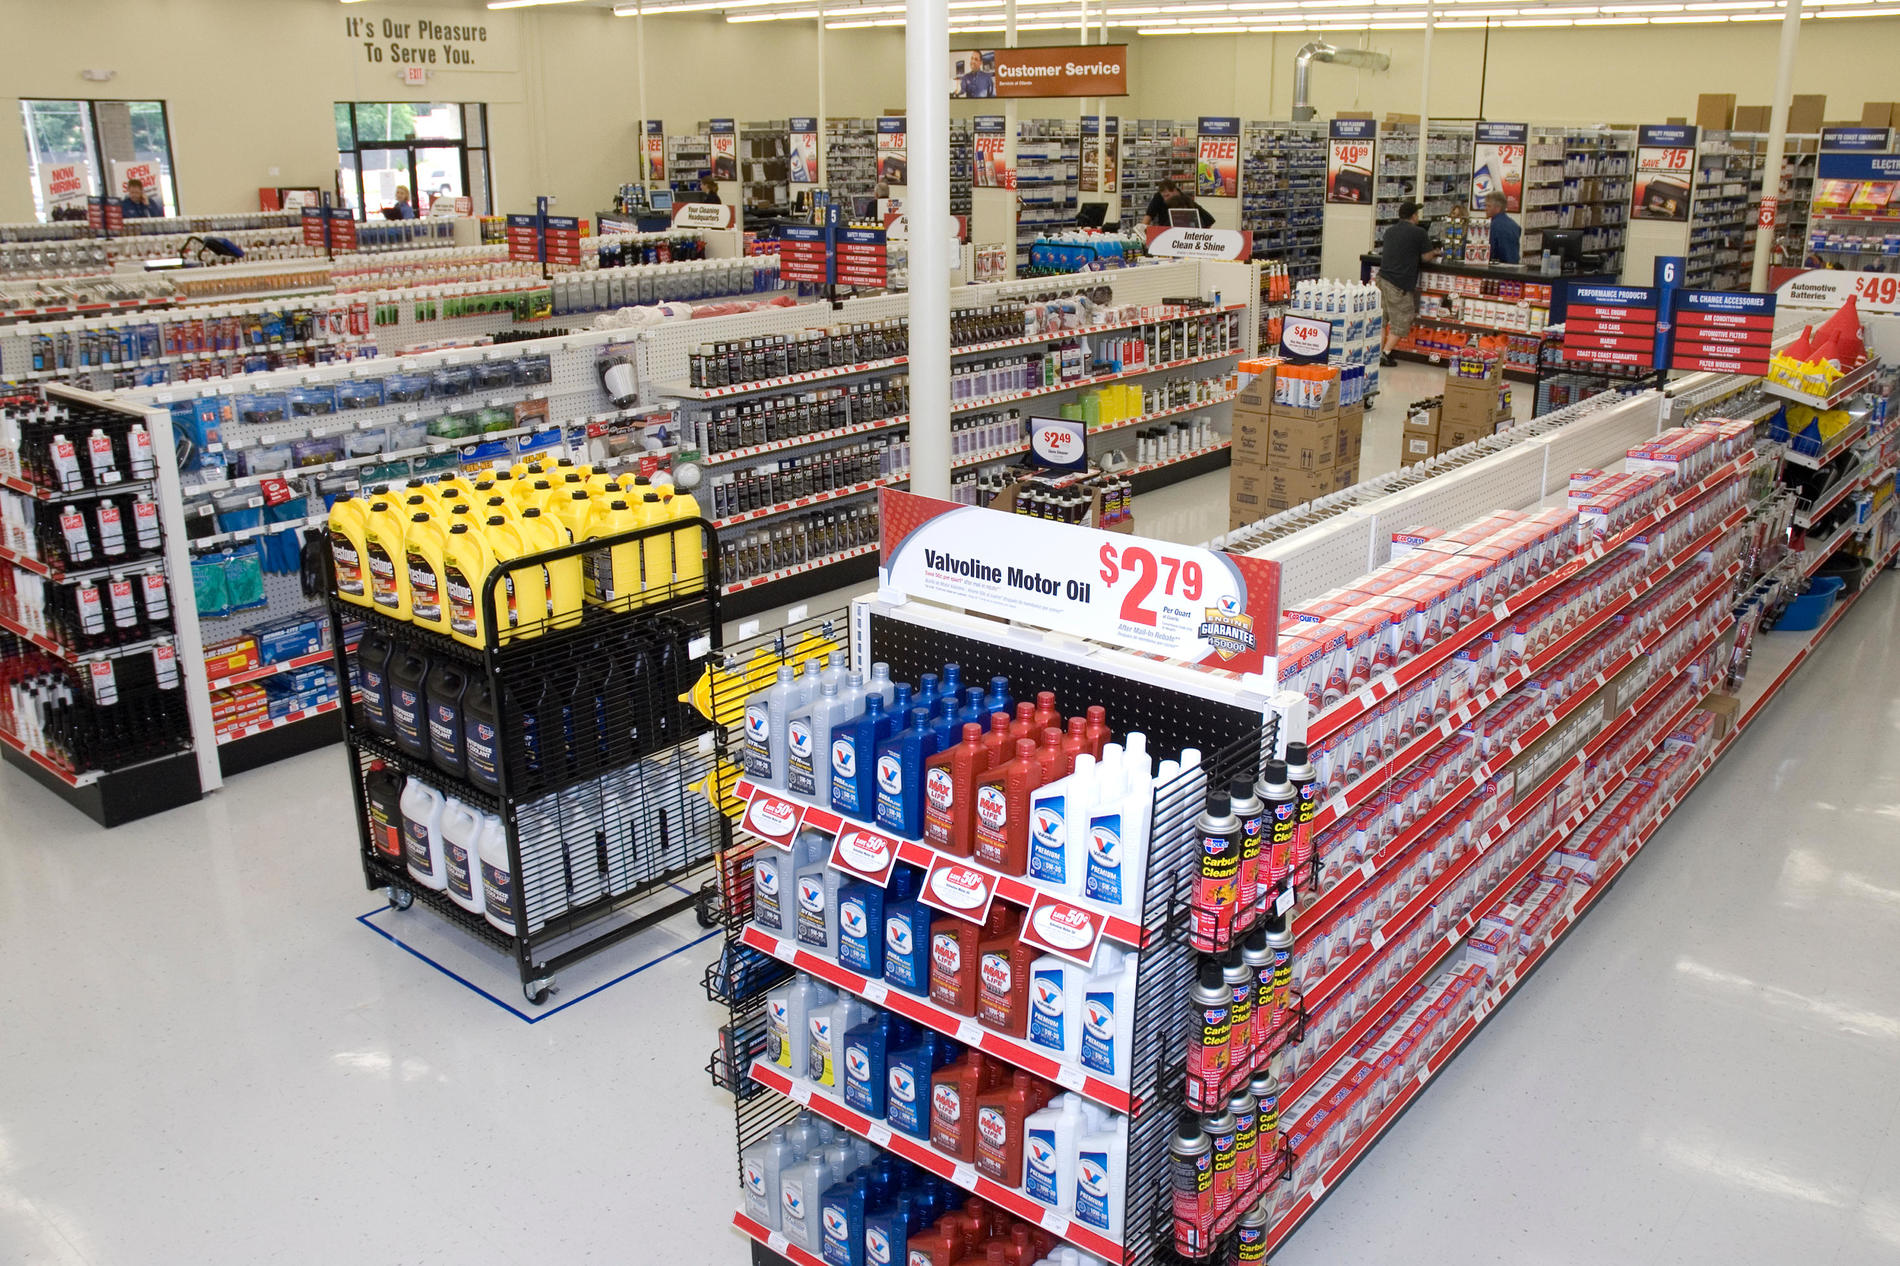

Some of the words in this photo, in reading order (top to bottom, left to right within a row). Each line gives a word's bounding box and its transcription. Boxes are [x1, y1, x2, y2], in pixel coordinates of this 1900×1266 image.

[346, 17, 374, 38] It's
[382, 19, 411, 39] Our
[419, 20, 487, 42] Pleasure
[364, 43, 382, 62] To
[391, 44, 436, 63] Serve
[444, 45, 475, 65] You.
[409, 67, 422, 80] EXIT
[998, 64, 1062, 77] Customer
[1065, 61, 1120, 76] Service
[976, 138, 1005, 152] FREE
[1200, 142, 1236, 159] FREE
[1641, 159, 1660, 168] SAVE
[1662, 148, 1688, 168] $15
[52, 166, 75, 182] NOW
[126, 164, 150, 180] OPEN
[50, 176, 81, 194] HIRING
[540, 202, 546, 212] 4
[688, 206, 698, 214] Your
[699, 207, 720, 215] Cleaning
[688, 213, 720, 222] Headquarters
[831, 210, 836, 222] 5
[1184, 232, 1212, 242] Interior
[1171, 240, 1194, 250] Clean
[1195, 242, 1201, 250] &
[1202, 242, 1226, 252] Shine
[1664, 263, 1674, 283] 6
[1578, 288, 1618, 298] PERFORMANCE
[1618, 291, 1648, 300] PRODUCTS
[1792, 283, 1836, 292] Automotive
[1856, 277, 1900, 304] $49
[1689, 294, 1698, 302] OIL
[1700, 296, 1722, 304] CHANGE
[1724, 296, 1764, 306] ACCESSORIES
[1790, 292, 1826, 300] Batteries
[1713, 316, 1746, 324] CONDITIONING
[1699, 330, 1728, 338] AUTOMOTIVE
[1044, 432, 1071, 448] $249
[1397, 535, 1425, 544] CARQUEST
[924, 549, 1001, 584] Valvoline
[1008, 566, 1060, 596] Motor
[1066, 580, 1090, 604] Oil
[1163, 606, 1172, 614] Per
[1174, 608, 1191, 618] Quart
[1288, 612, 1320, 623] CARQUEST
[1118, 624, 1132, 634] After
[1208, 616, 1248, 630] ENGINE
[1201, 624, 1255, 646] GUARANTEE
[1324, 633, 1346, 651] CARQUEST
[1301, 648, 1322, 666] CARQUEST
[929, 778, 950, 796] MAX
[931, 791, 946, 802] LIFE
[980, 798, 1003, 816] MAX
[982, 810, 998, 820] LIFE
[1035, 845, 1060, 860] PREMIUM
[1090, 864, 1116, 880] PREMIUM
[935, 944, 957, 962] MAX
[938, 956, 952, 966] LIFE
[983, 964, 1008, 982] MAX
[986, 974, 1002, 986] LIFE
[1034, 1012, 1059, 1027] PREMIUM
[1085, 1034, 1110, 1050] PREMIUM
[936, 1093, 958, 1112] MAX
[938, 1104, 953, 1116] LIFE
[980, 1118, 1004, 1136] MAX
[984, 1128, 999, 1139] LIFE
[1030, 1168, 1053, 1184] PREMIUM
[1080, 1190, 1104, 1207] PREMIUM
